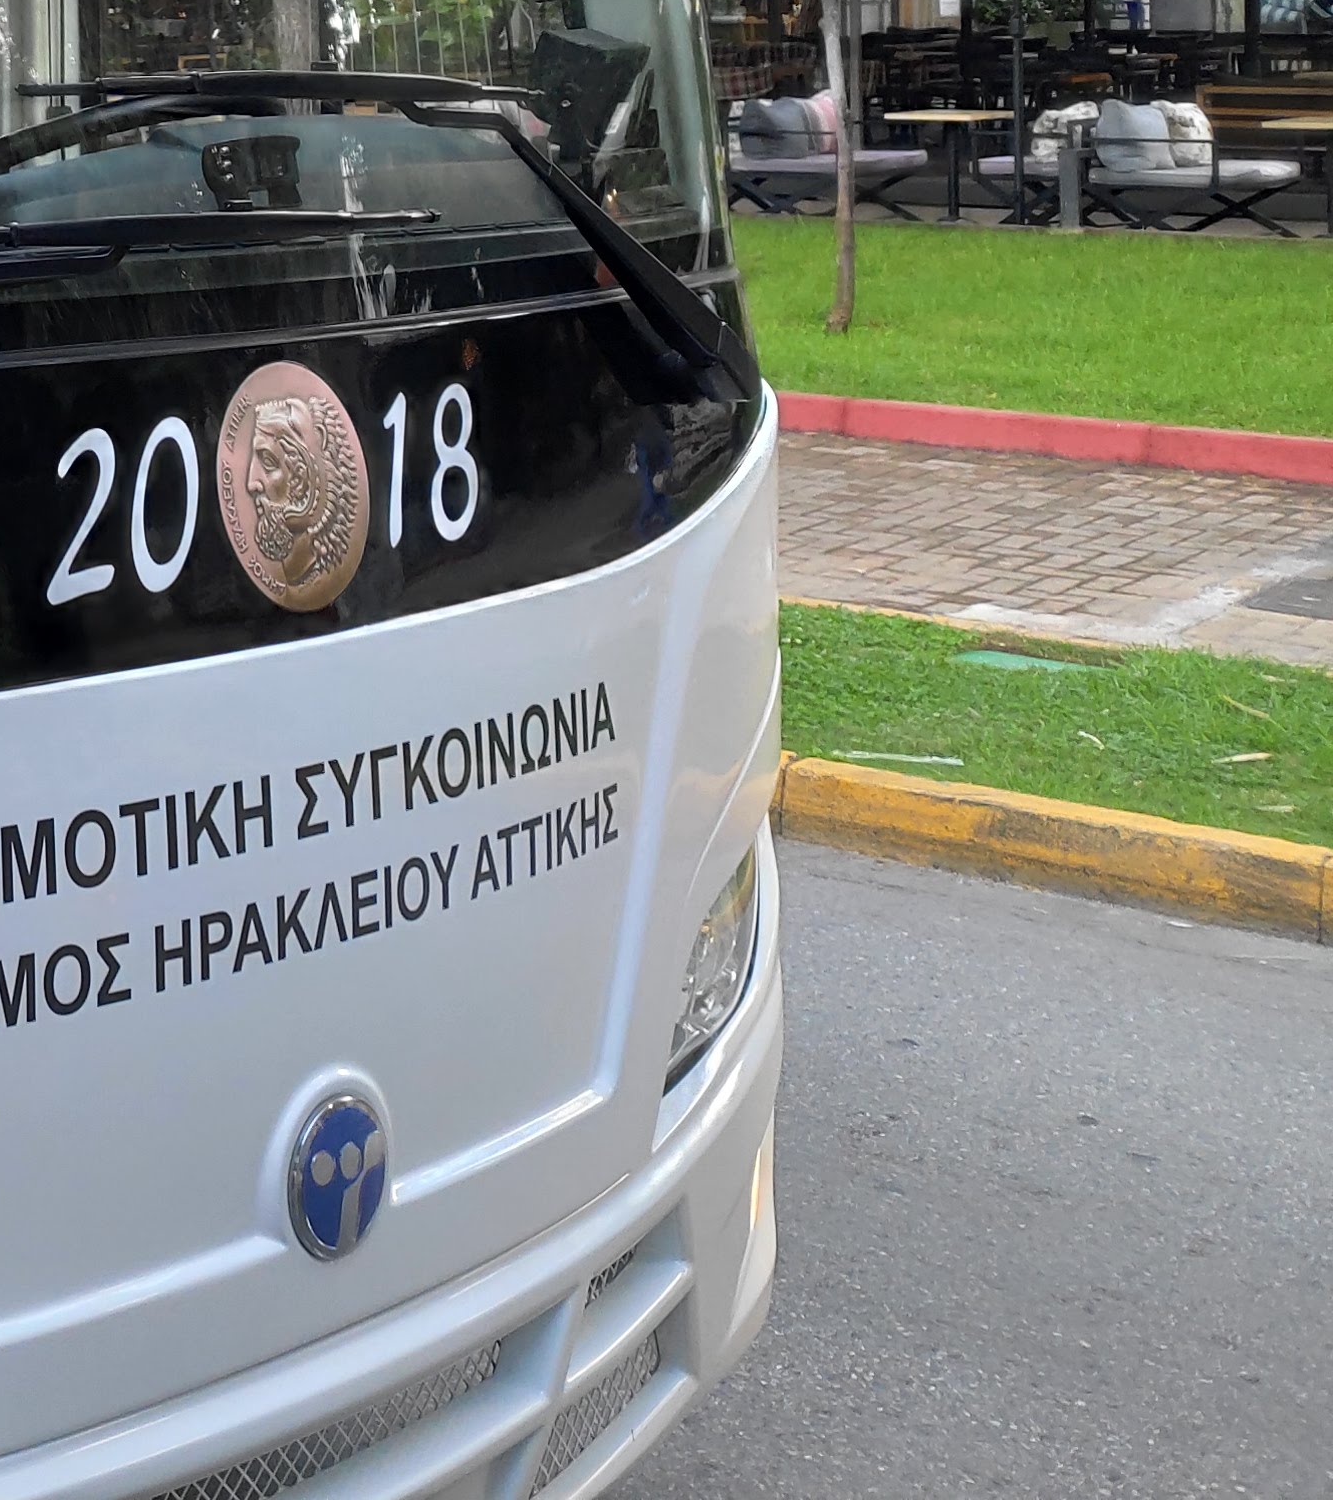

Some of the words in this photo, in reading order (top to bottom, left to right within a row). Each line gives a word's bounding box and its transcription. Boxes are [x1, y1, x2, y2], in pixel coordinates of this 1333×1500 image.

[47, 416, 200, 606] 20
[383, 383, 482, 549] 18
[296, 682, 616, 839] ΣΥΓΚΟΙΝΩΝΙΑ
[155, 843, 459, 994] ΗΡΑΚΛΕΙΟΥ
[471, 783, 620, 901] ΑΤΤΙΚΗΣ
